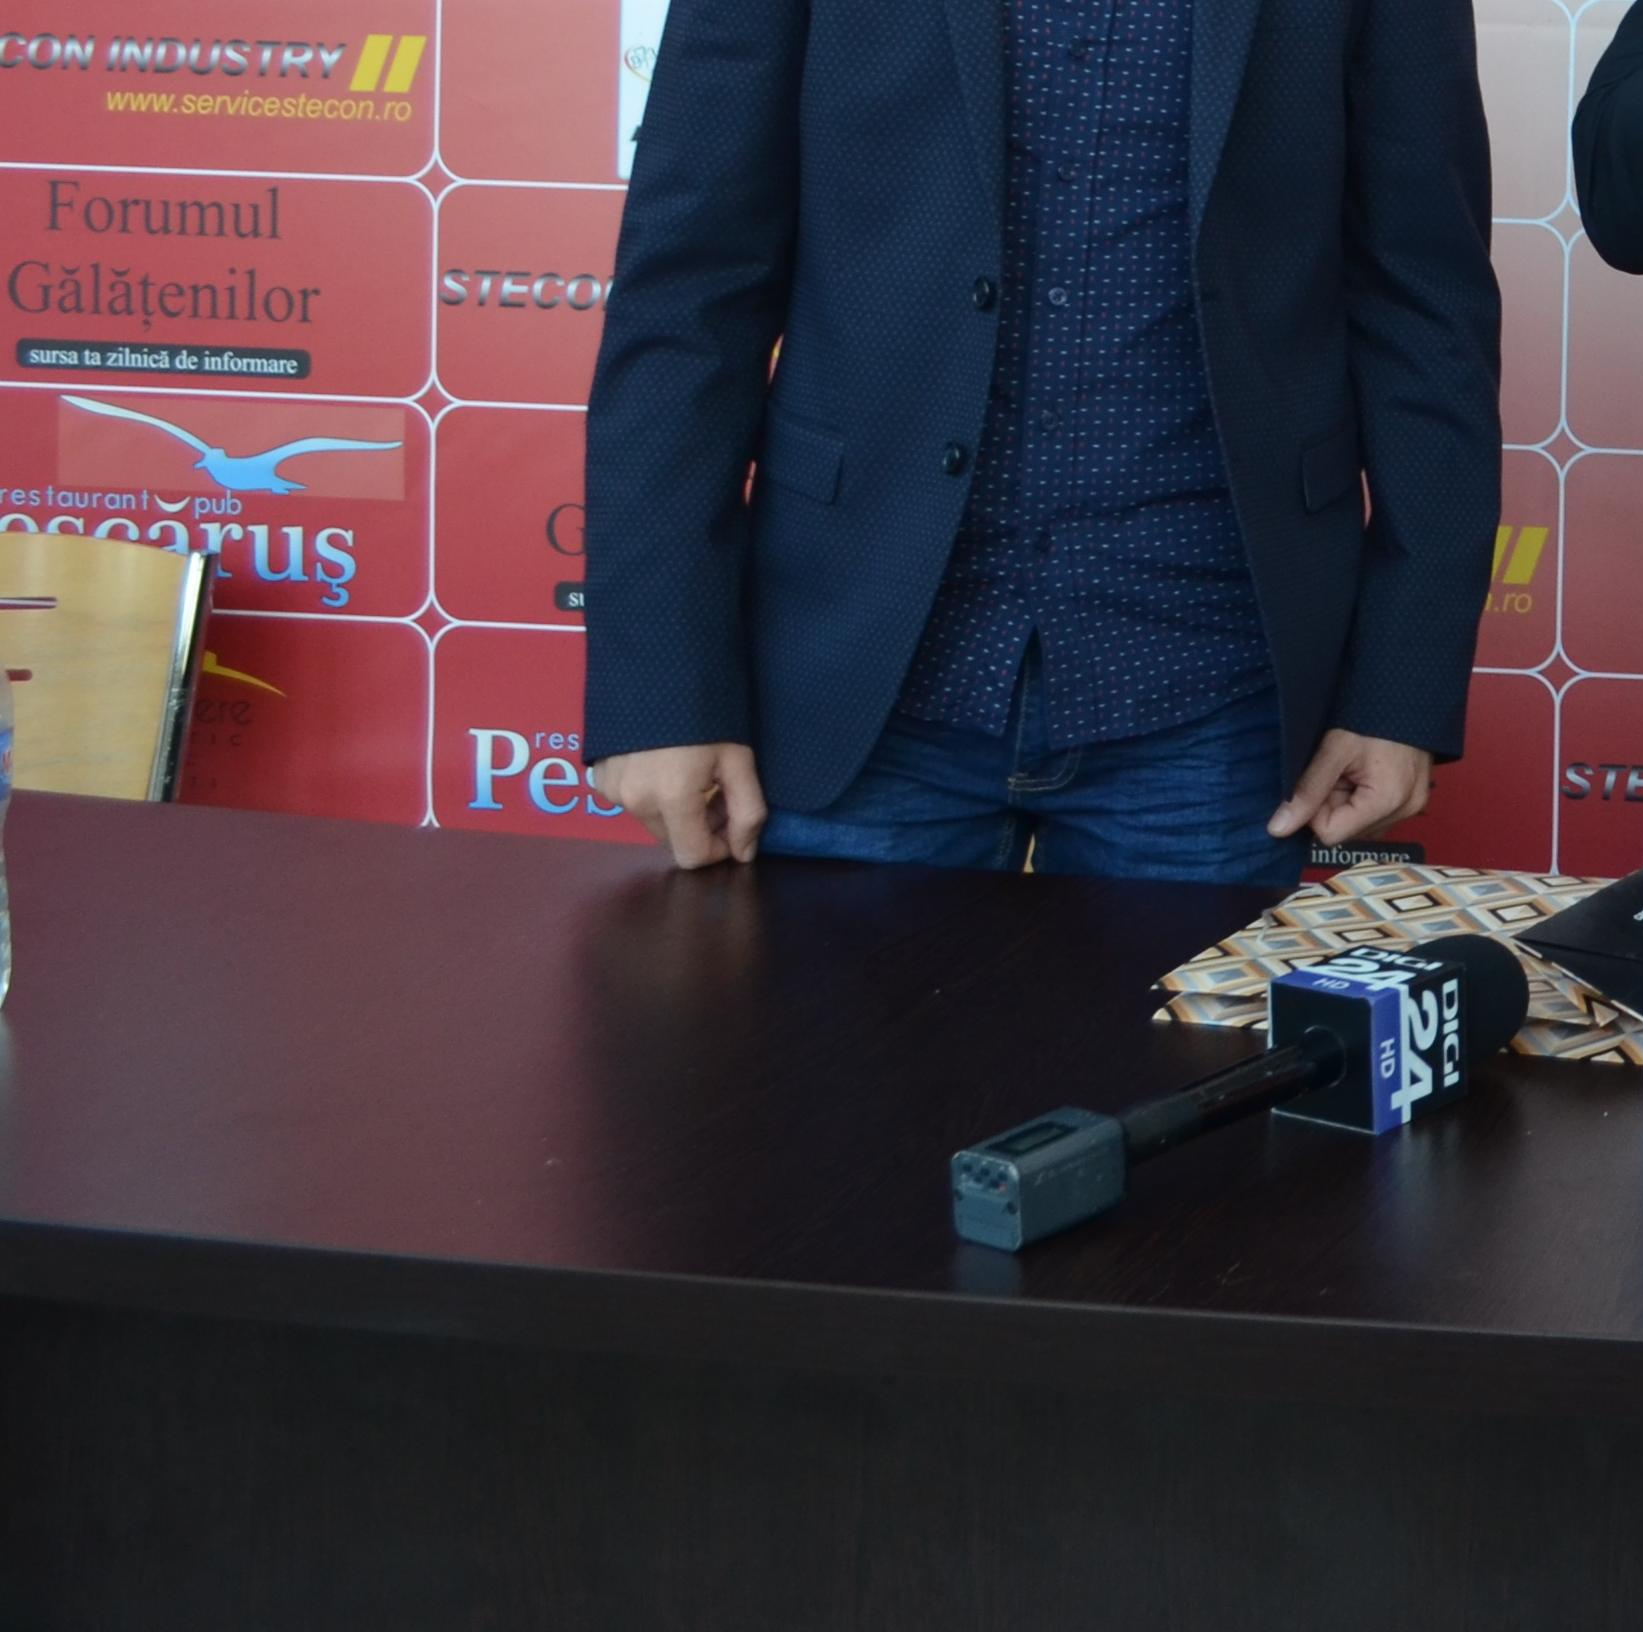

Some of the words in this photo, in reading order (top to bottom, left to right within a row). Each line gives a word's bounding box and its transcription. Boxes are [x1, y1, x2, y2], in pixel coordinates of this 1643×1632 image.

[104, 35, 347, 80] INDUSTRY
[105, 88, 413, 123] www.servicestecon.ro
[45, 178, 281, 241] Forumul
[7, 258, 321, 336] Gălățenilor
[29, 349, 79, 366] sursa
[84, 350, 102, 367] ta
[106, 347, 170, 370] zilnică
[174, 349, 199, 371] de
[203, 349, 299, 375] informare
[194, 489, 243, 520] pub
[1299, 956, 1417, 992] 24
[1349, 948, 1444, 971] DIGI
[1312, 977, 1351, 990] HD
[1442, 978, 1460, 1088] DIGI
[1379, 1037, 1396, 1079] HD
[1391, 983, 1439, 1124] 24
